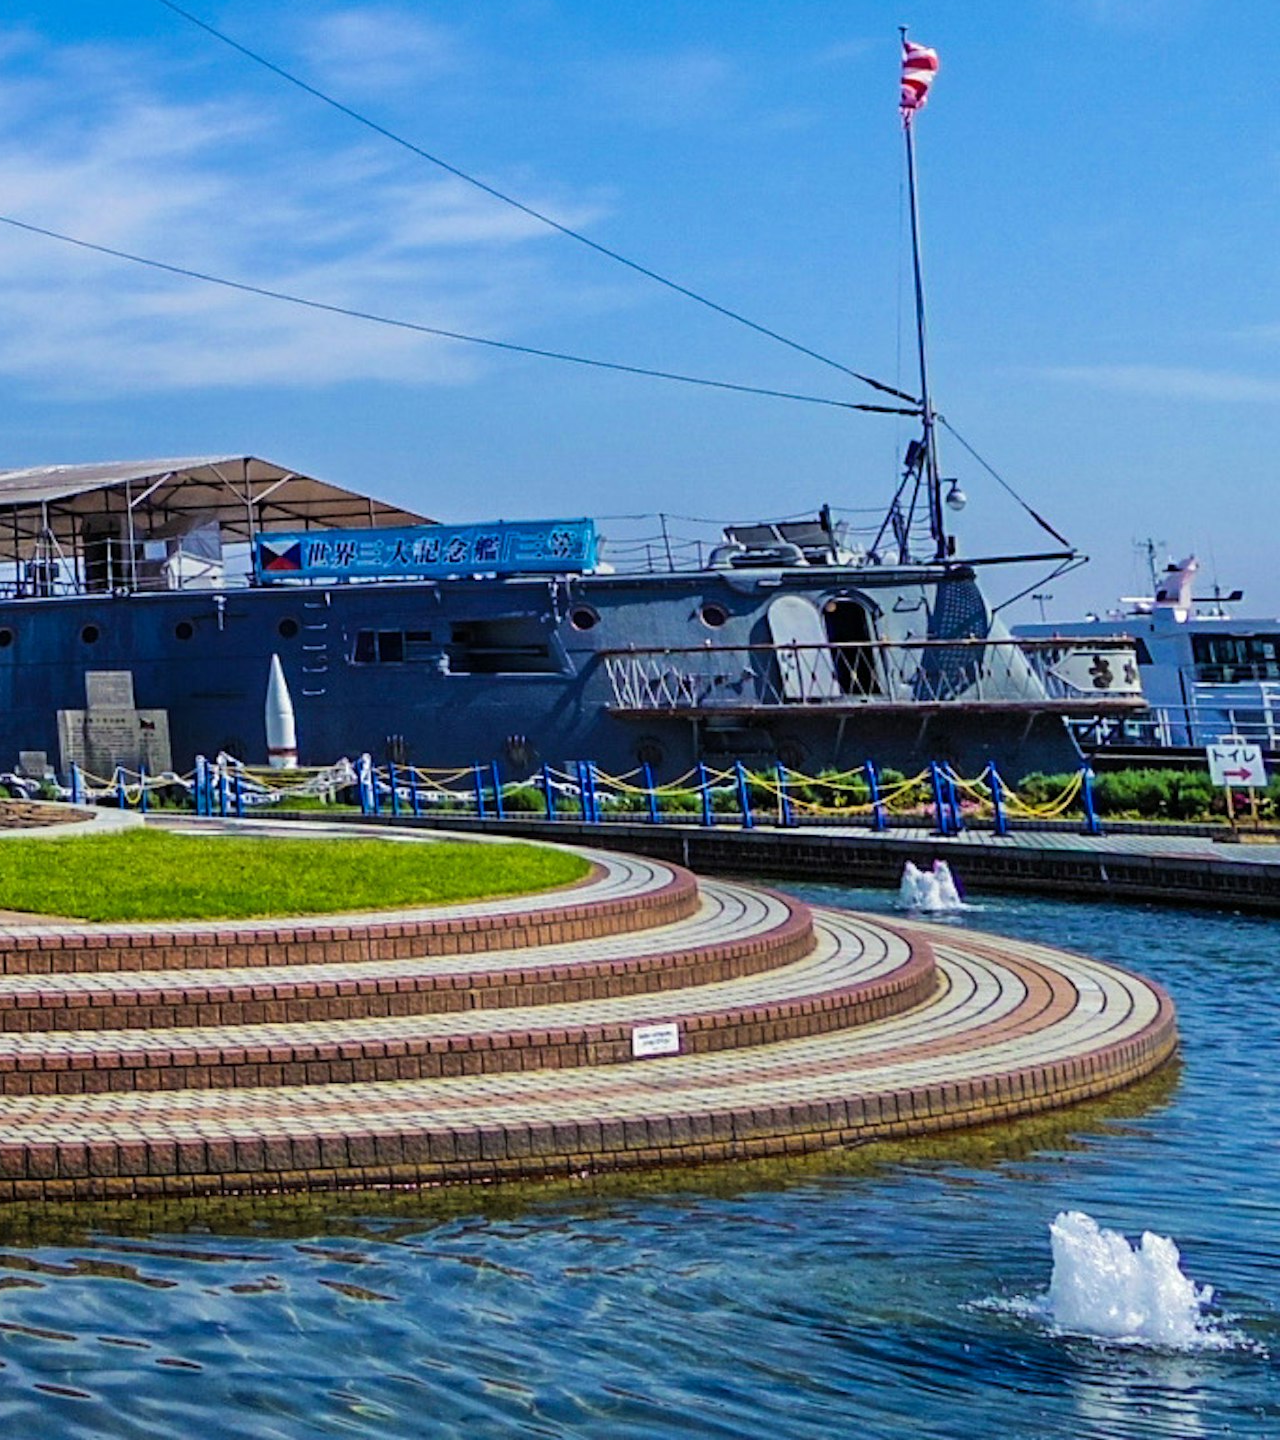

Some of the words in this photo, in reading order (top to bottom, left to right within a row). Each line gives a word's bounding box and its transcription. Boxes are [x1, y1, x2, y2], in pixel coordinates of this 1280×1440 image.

[305, 529, 590, 568] 世界三大記念艦「三笠」
[1212, 748, 1256, 763] トイレ
